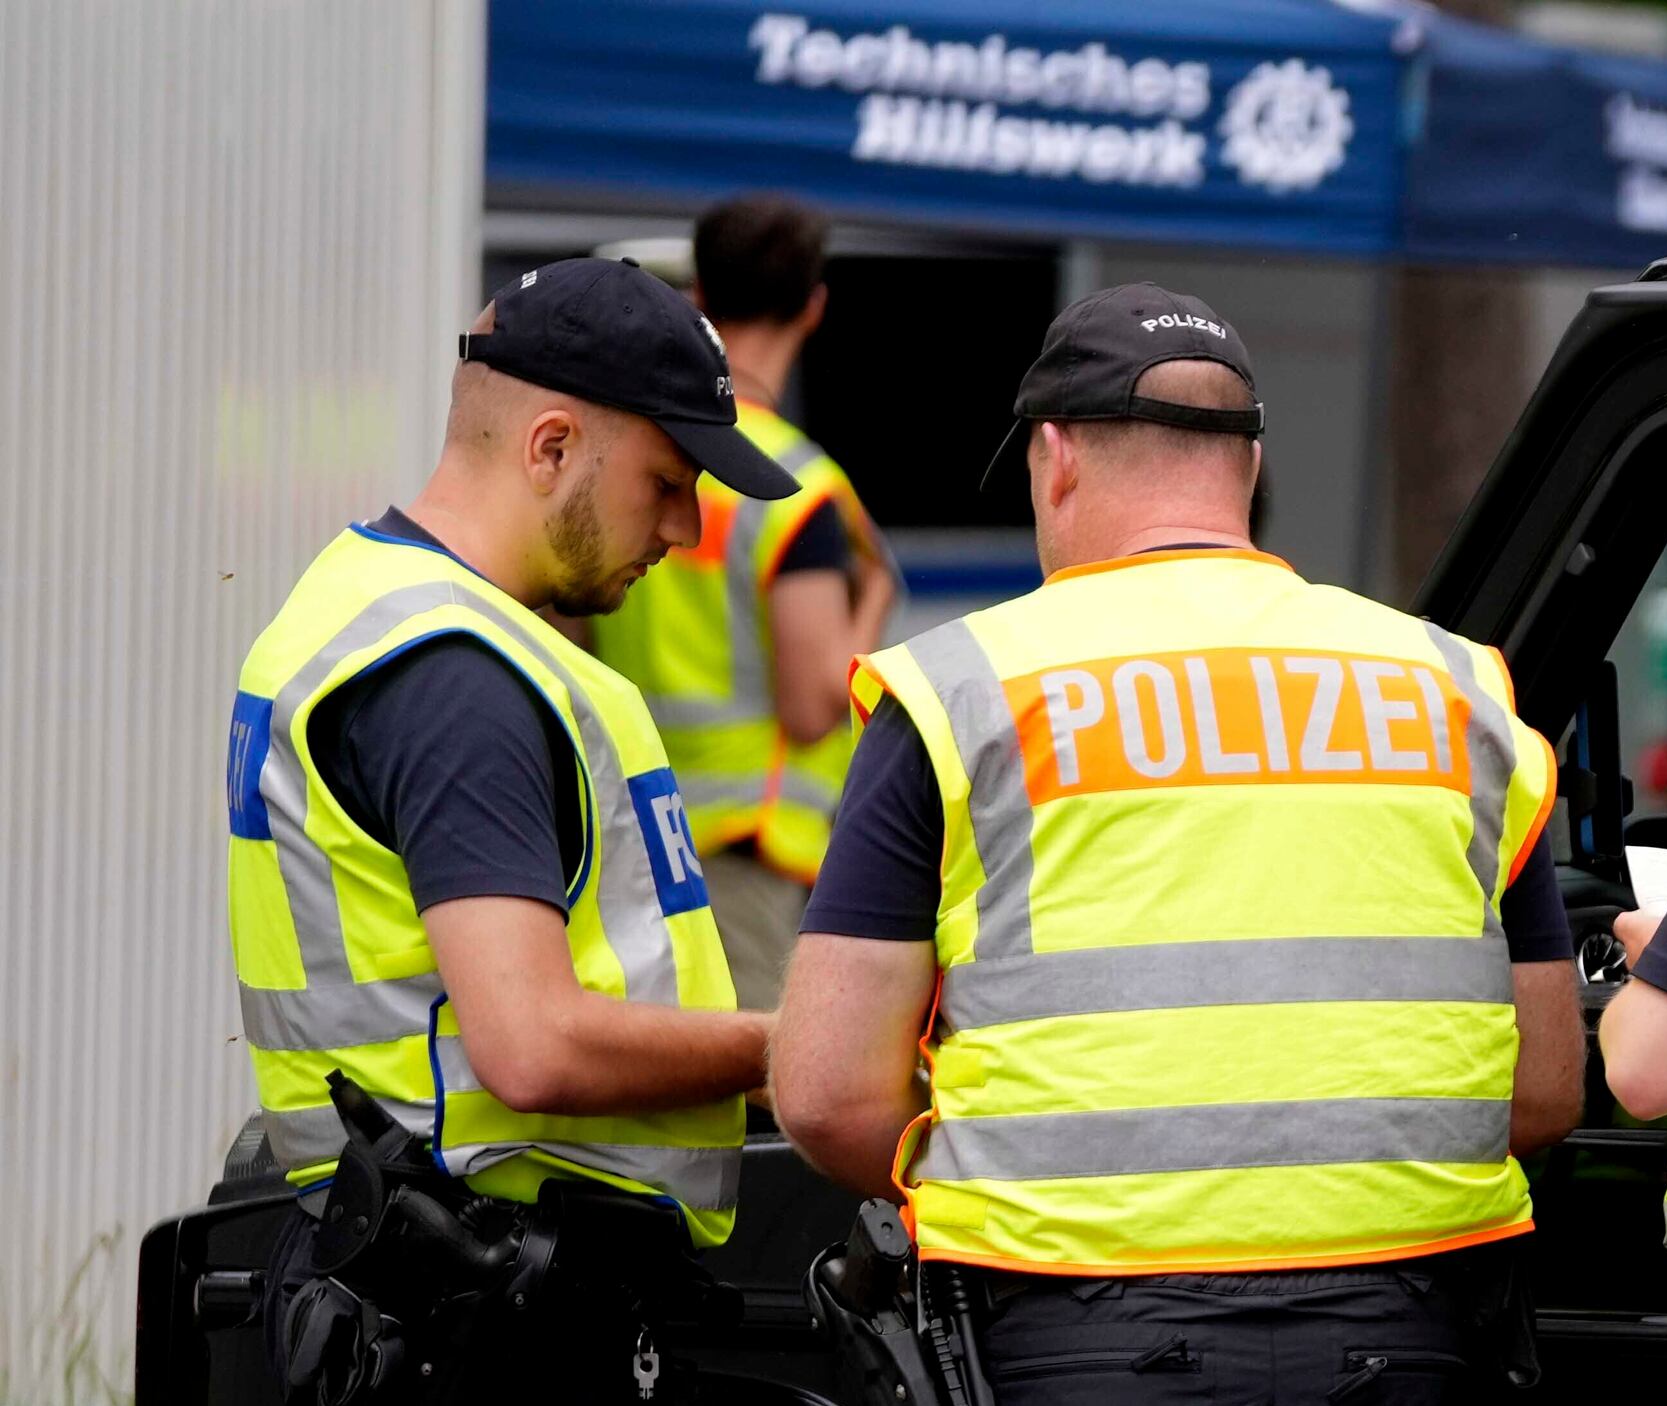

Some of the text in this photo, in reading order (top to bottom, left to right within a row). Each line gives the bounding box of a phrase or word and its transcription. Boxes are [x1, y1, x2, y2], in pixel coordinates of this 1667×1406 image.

[750, 14, 1210, 118] Technisches
[854, 95, 1206, 187] Hilfswerk
[1141, 313, 1226, 339] POLIZEI
[1040, 656, 1452, 787] POLIZEI
